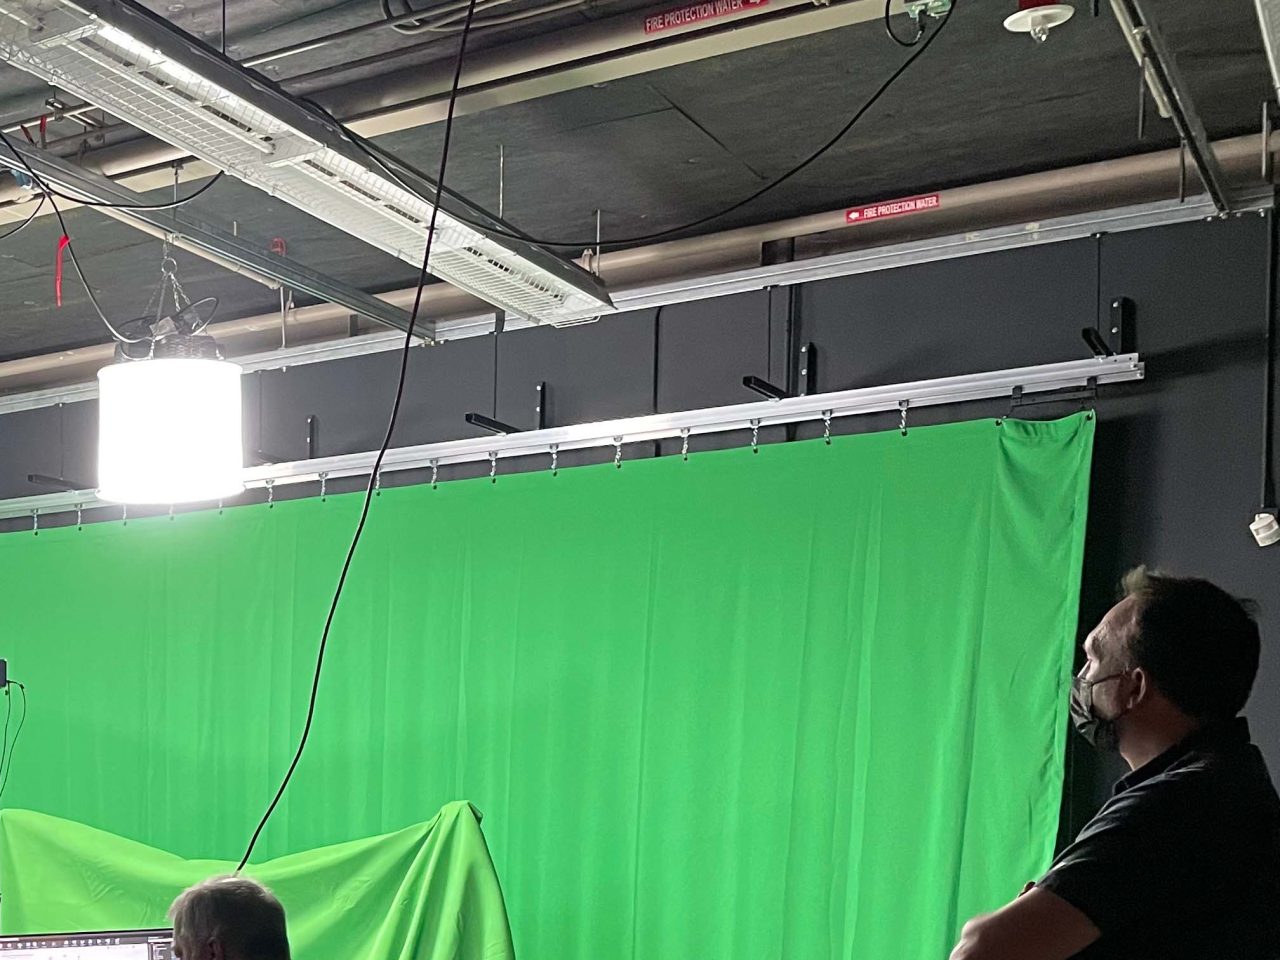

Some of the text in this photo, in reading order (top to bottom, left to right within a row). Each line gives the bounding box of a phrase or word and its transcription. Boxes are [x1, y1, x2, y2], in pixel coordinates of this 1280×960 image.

[646, 0, 743, 31] FIRE PROTECTION WATER
[863, 196, 938, 218] FIRE PROTECTION WATER
